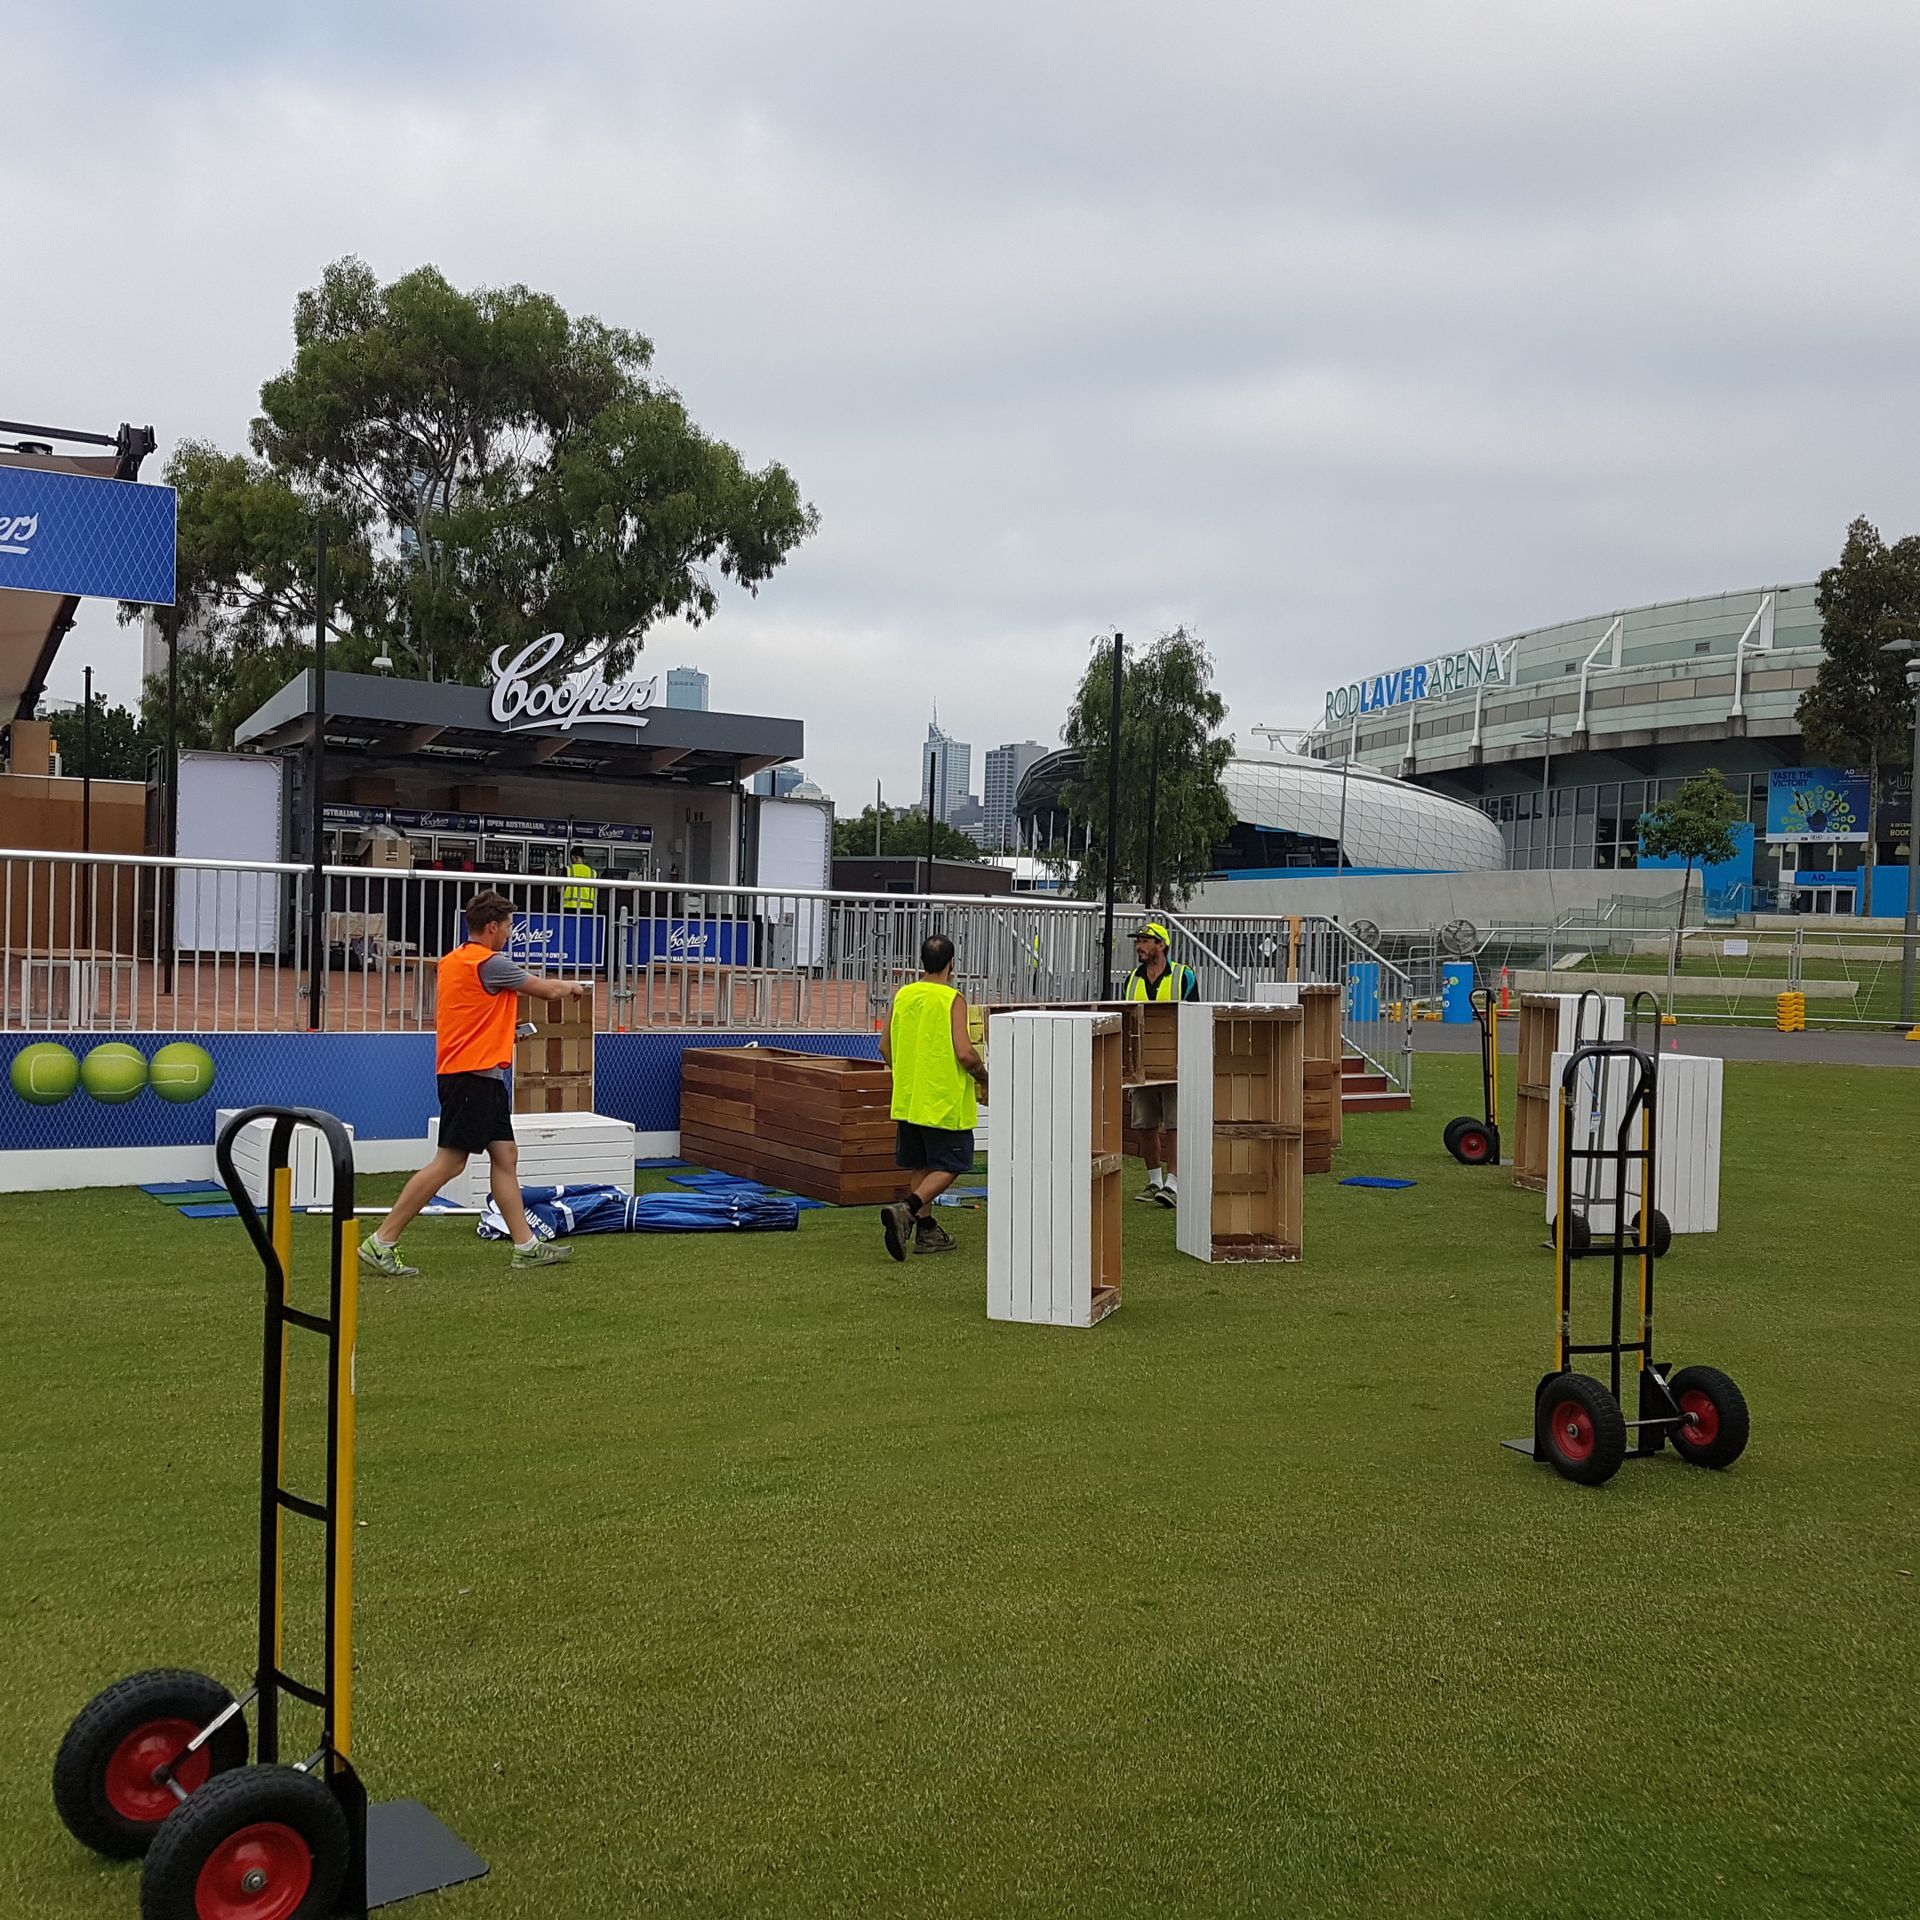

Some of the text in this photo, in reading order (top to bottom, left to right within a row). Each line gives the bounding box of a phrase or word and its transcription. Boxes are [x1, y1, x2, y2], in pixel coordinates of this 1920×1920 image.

[491, 632, 658, 733] Coopers
[1325, 643, 1505, 721] ROD LAVER ARENA
[1773, 770, 1815, 779] TASTE THE
[1772, 779, 1808, 788] VICTORY
[487, 819, 504, 828] OPEN
